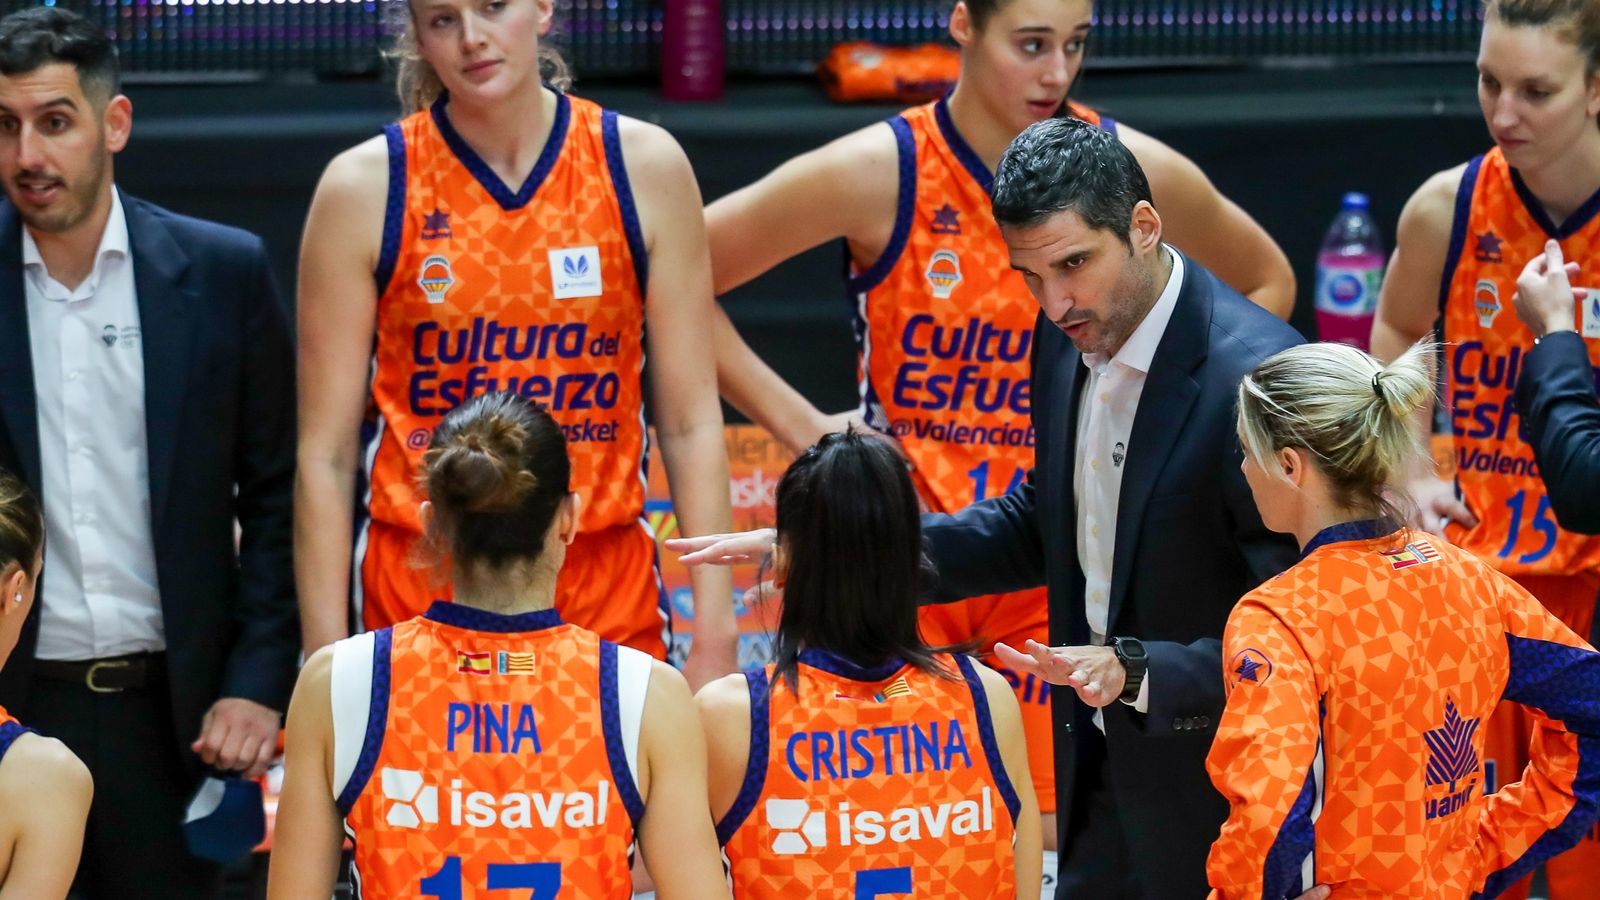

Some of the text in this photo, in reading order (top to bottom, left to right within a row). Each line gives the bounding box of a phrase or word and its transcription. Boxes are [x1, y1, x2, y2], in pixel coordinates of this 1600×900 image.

[413, 316, 621, 366] Cultura del
[901, 313, 1032, 364] Cultu
[892, 362, 1031, 415] Esfue
[1497, 489, 1558, 564] 15
[446, 702, 543, 754] PINA
[785, 718, 973, 783] CRISTINA
[450, 779, 609, 829] isaval
[838, 785, 993, 847] isaval
